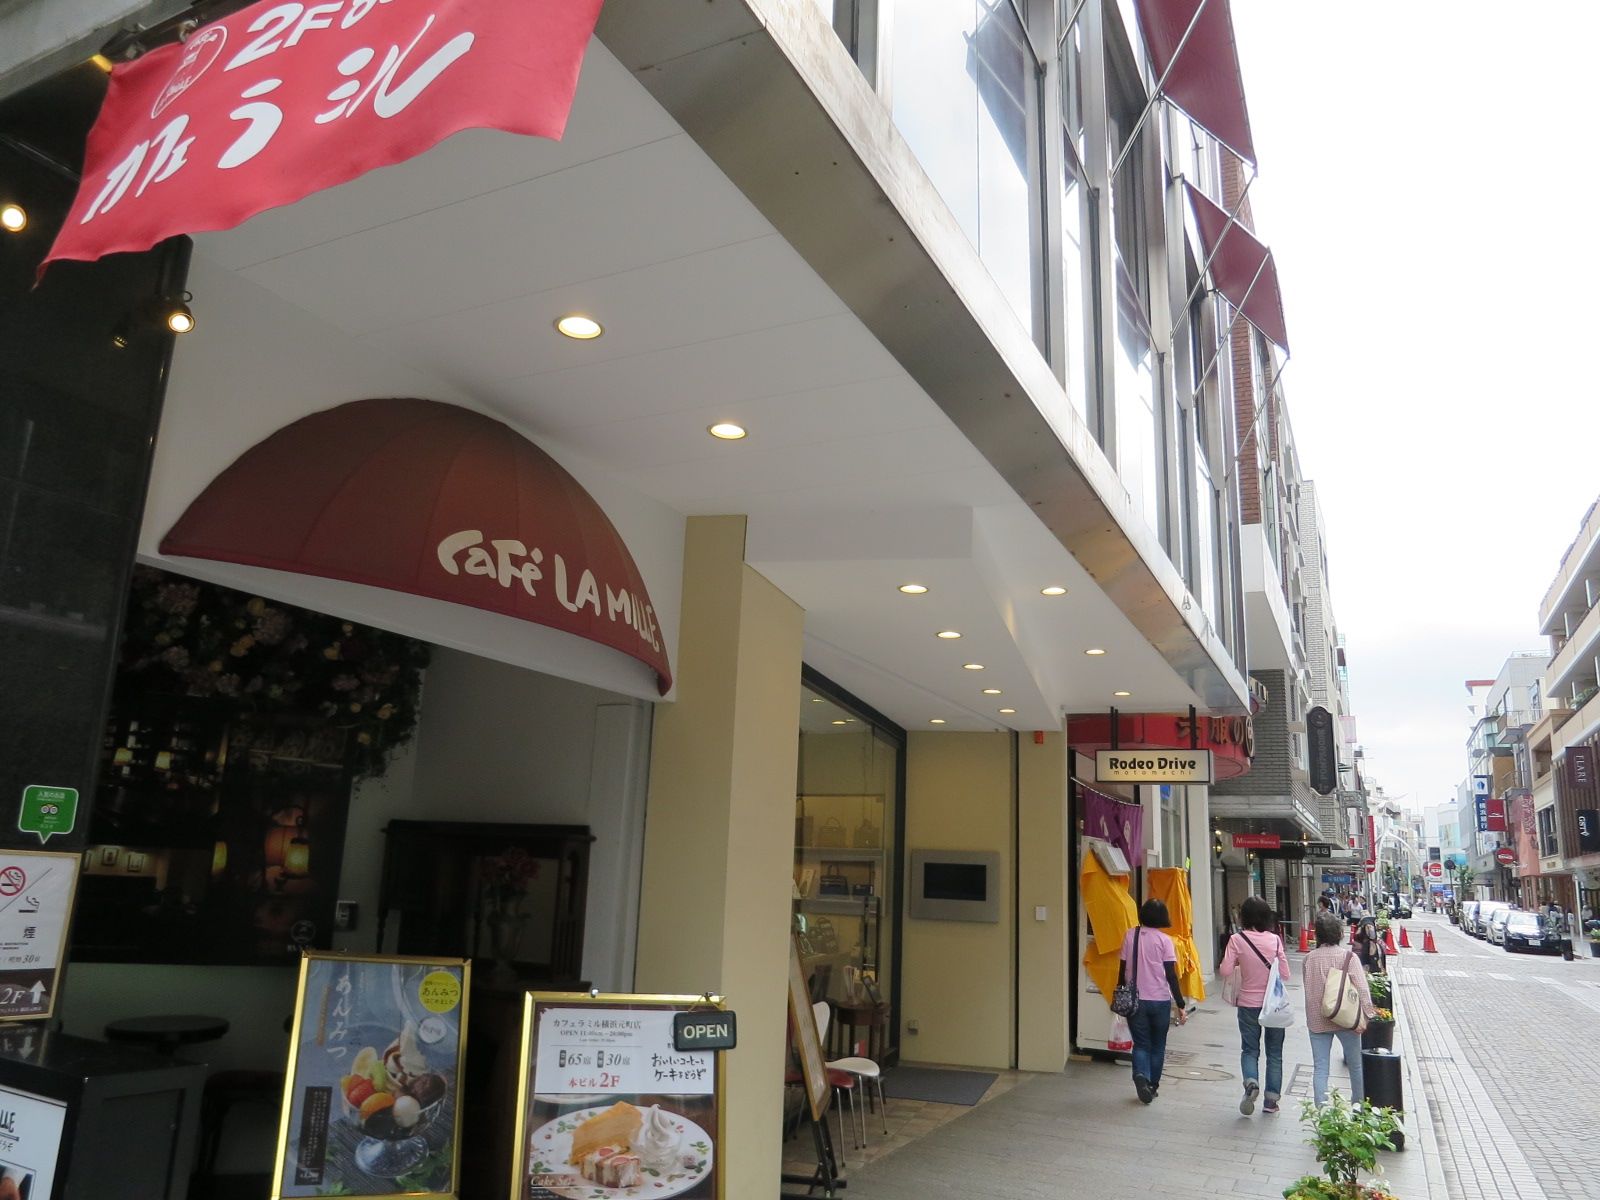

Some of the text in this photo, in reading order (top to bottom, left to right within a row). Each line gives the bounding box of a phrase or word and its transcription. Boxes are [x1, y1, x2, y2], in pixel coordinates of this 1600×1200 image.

[554, 553, 601, 617] LA
[1109, 757, 1196, 770] Rodeo Drive
[422, 987, 459, 996] あんみつ
[327, 974, 352, 1058] あんみつ
[683, 1023, 728, 1039] OPEN
